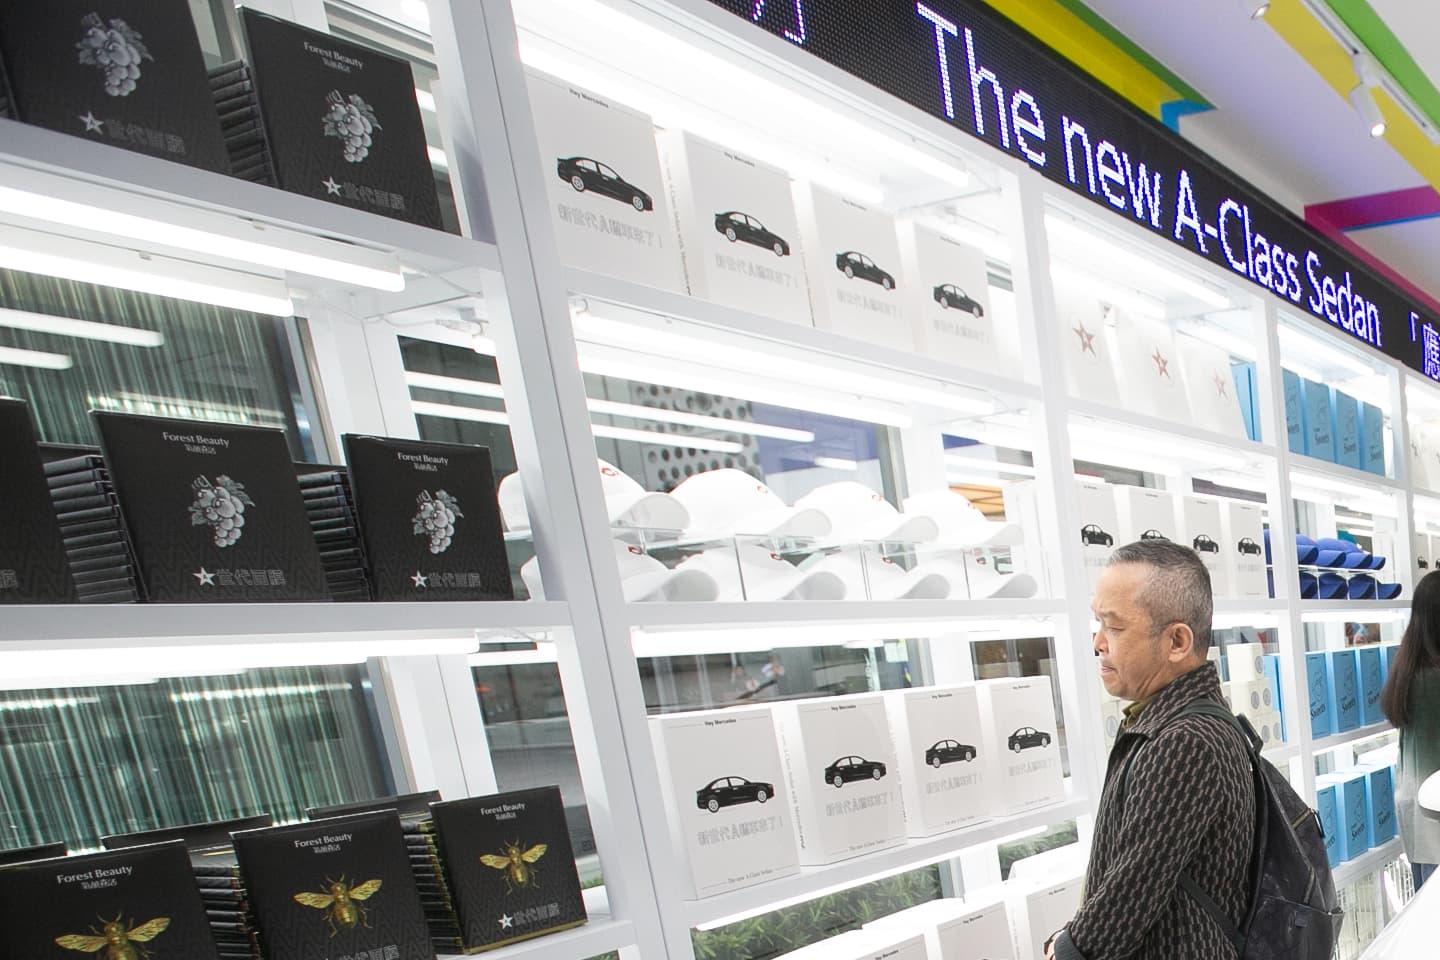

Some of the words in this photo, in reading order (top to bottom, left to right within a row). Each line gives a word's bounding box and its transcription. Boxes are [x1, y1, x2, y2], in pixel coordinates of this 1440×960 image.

[304, 41, 333, 59] Forest
[333, 50, 364, 69] Beauty
[917, 1, 1046, 168] The
[1062, 115, 1162, 229] new
[1174, 169, 1302, 299] A-Class
[1307, 251, 1383, 348] Sedan
[163, 432, 195, 444] Forest
[196, 434, 230, 447] Beauty
[398, 452, 422, 462] Forest
[423, 454, 448, 466] Beauty
[481, 806, 502, 816] Forest
[502, 802, 526, 812] Beauty
[294, 838, 323, 849] Forest
[323, 833, 353, 845] Beauty
[57, 871, 93, 885] Forest
[95, 865, 133, 880] Beauty
